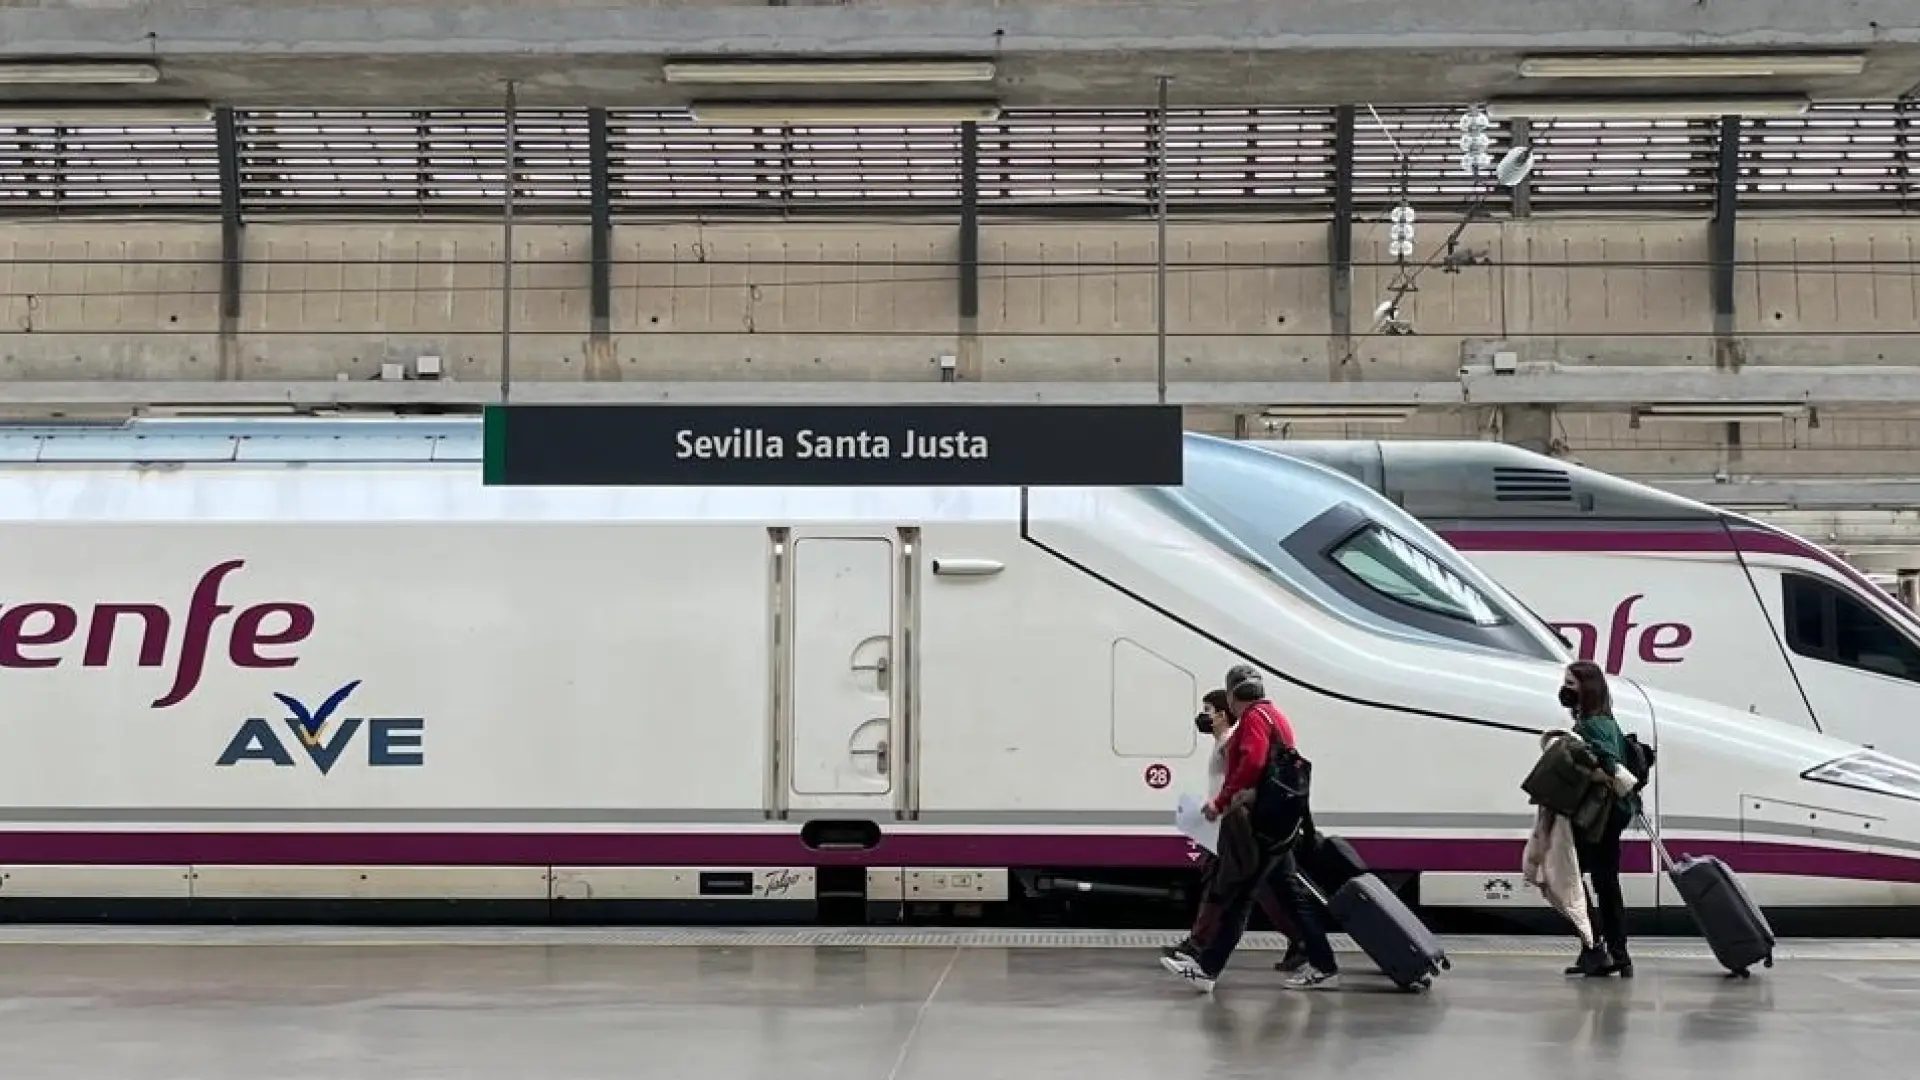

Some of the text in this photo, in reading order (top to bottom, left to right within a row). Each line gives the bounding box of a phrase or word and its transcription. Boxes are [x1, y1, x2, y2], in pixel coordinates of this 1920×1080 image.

[675, 428, 988, 457] Sevilla Santa Justa
[0, 558, 315, 708] enfe
[1548, 593, 1693, 676] nfe
[215, 715, 424, 776] AVE
[1149, 768, 1168, 785] 28
